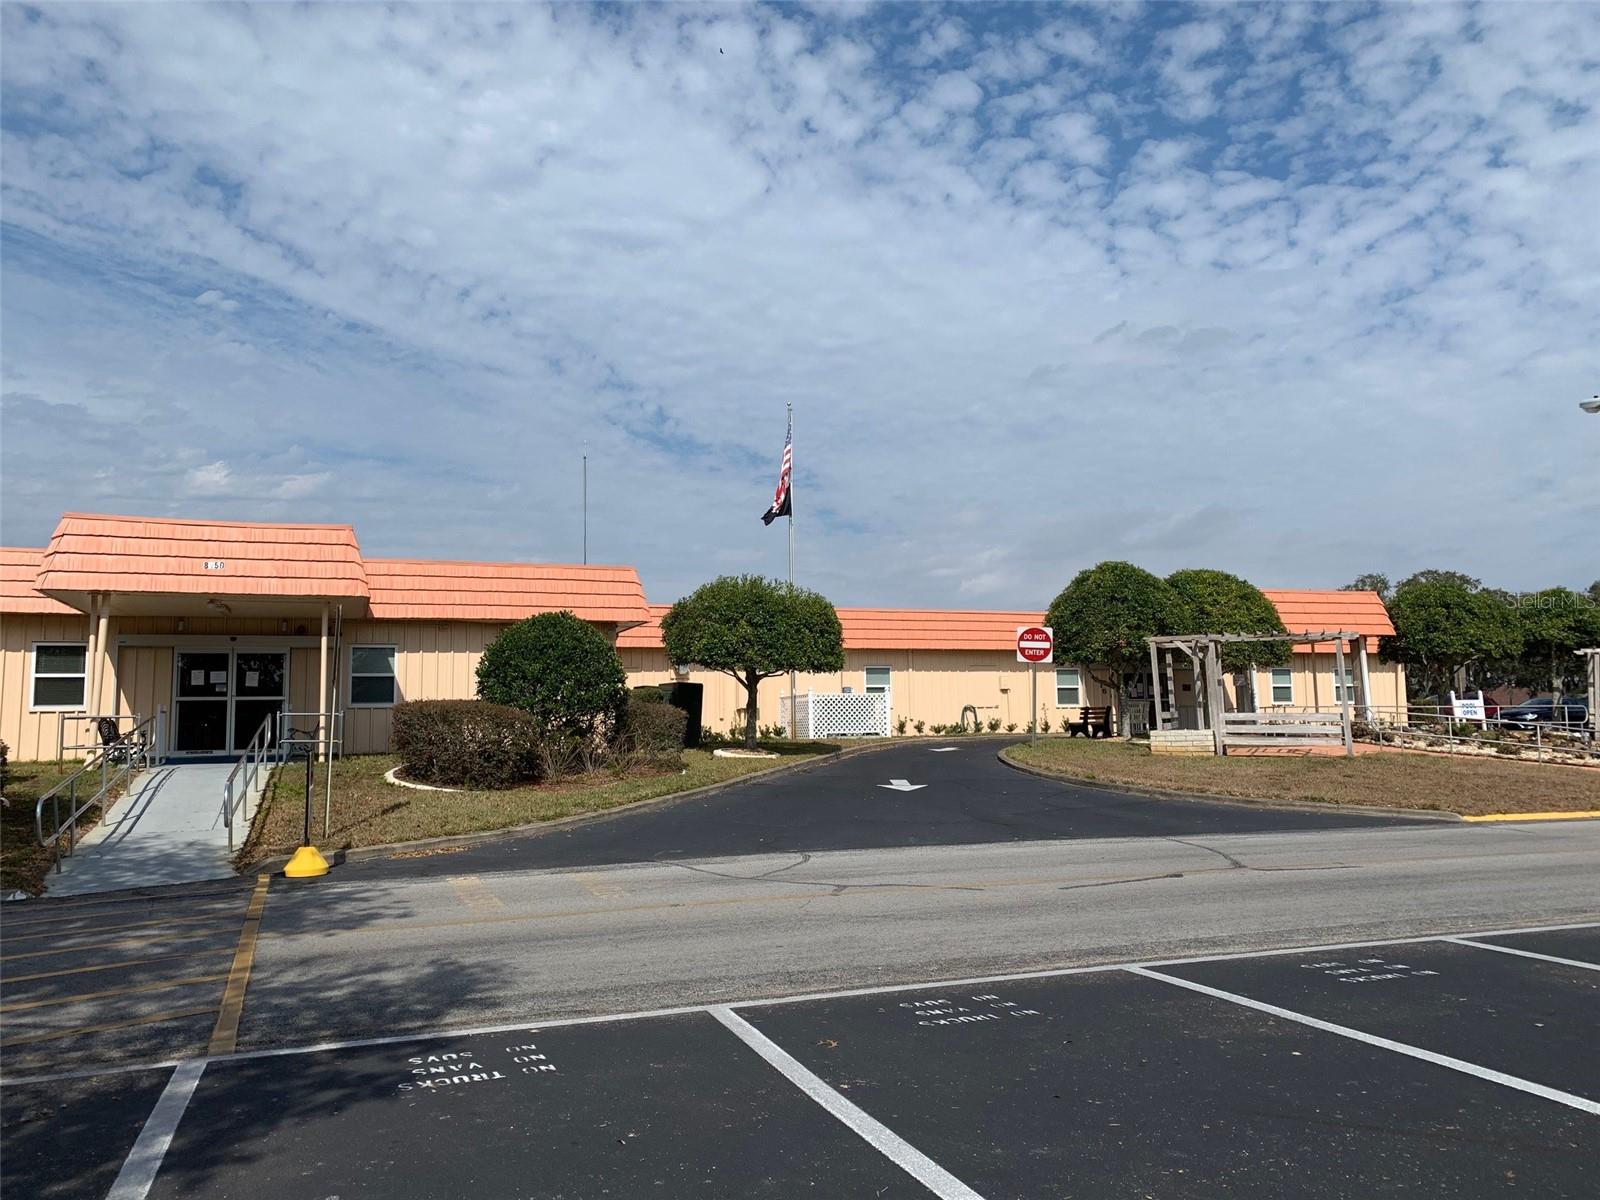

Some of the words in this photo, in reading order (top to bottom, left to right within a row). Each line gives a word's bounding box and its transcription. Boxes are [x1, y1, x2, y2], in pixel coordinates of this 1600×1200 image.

[204, 561, 225, 570] 850
[918, 1013, 1001, 1027] TRUCKS
[505, 1044, 538, 1053] NO
[408, 1051, 474, 1065] SUVS
[513, 1053, 547, 1064] NO
[411, 1062, 484, 1076] VANS
[521, 1064, 557, 1075] NO
[397, 1070, 507, 1091] TRUCKS
